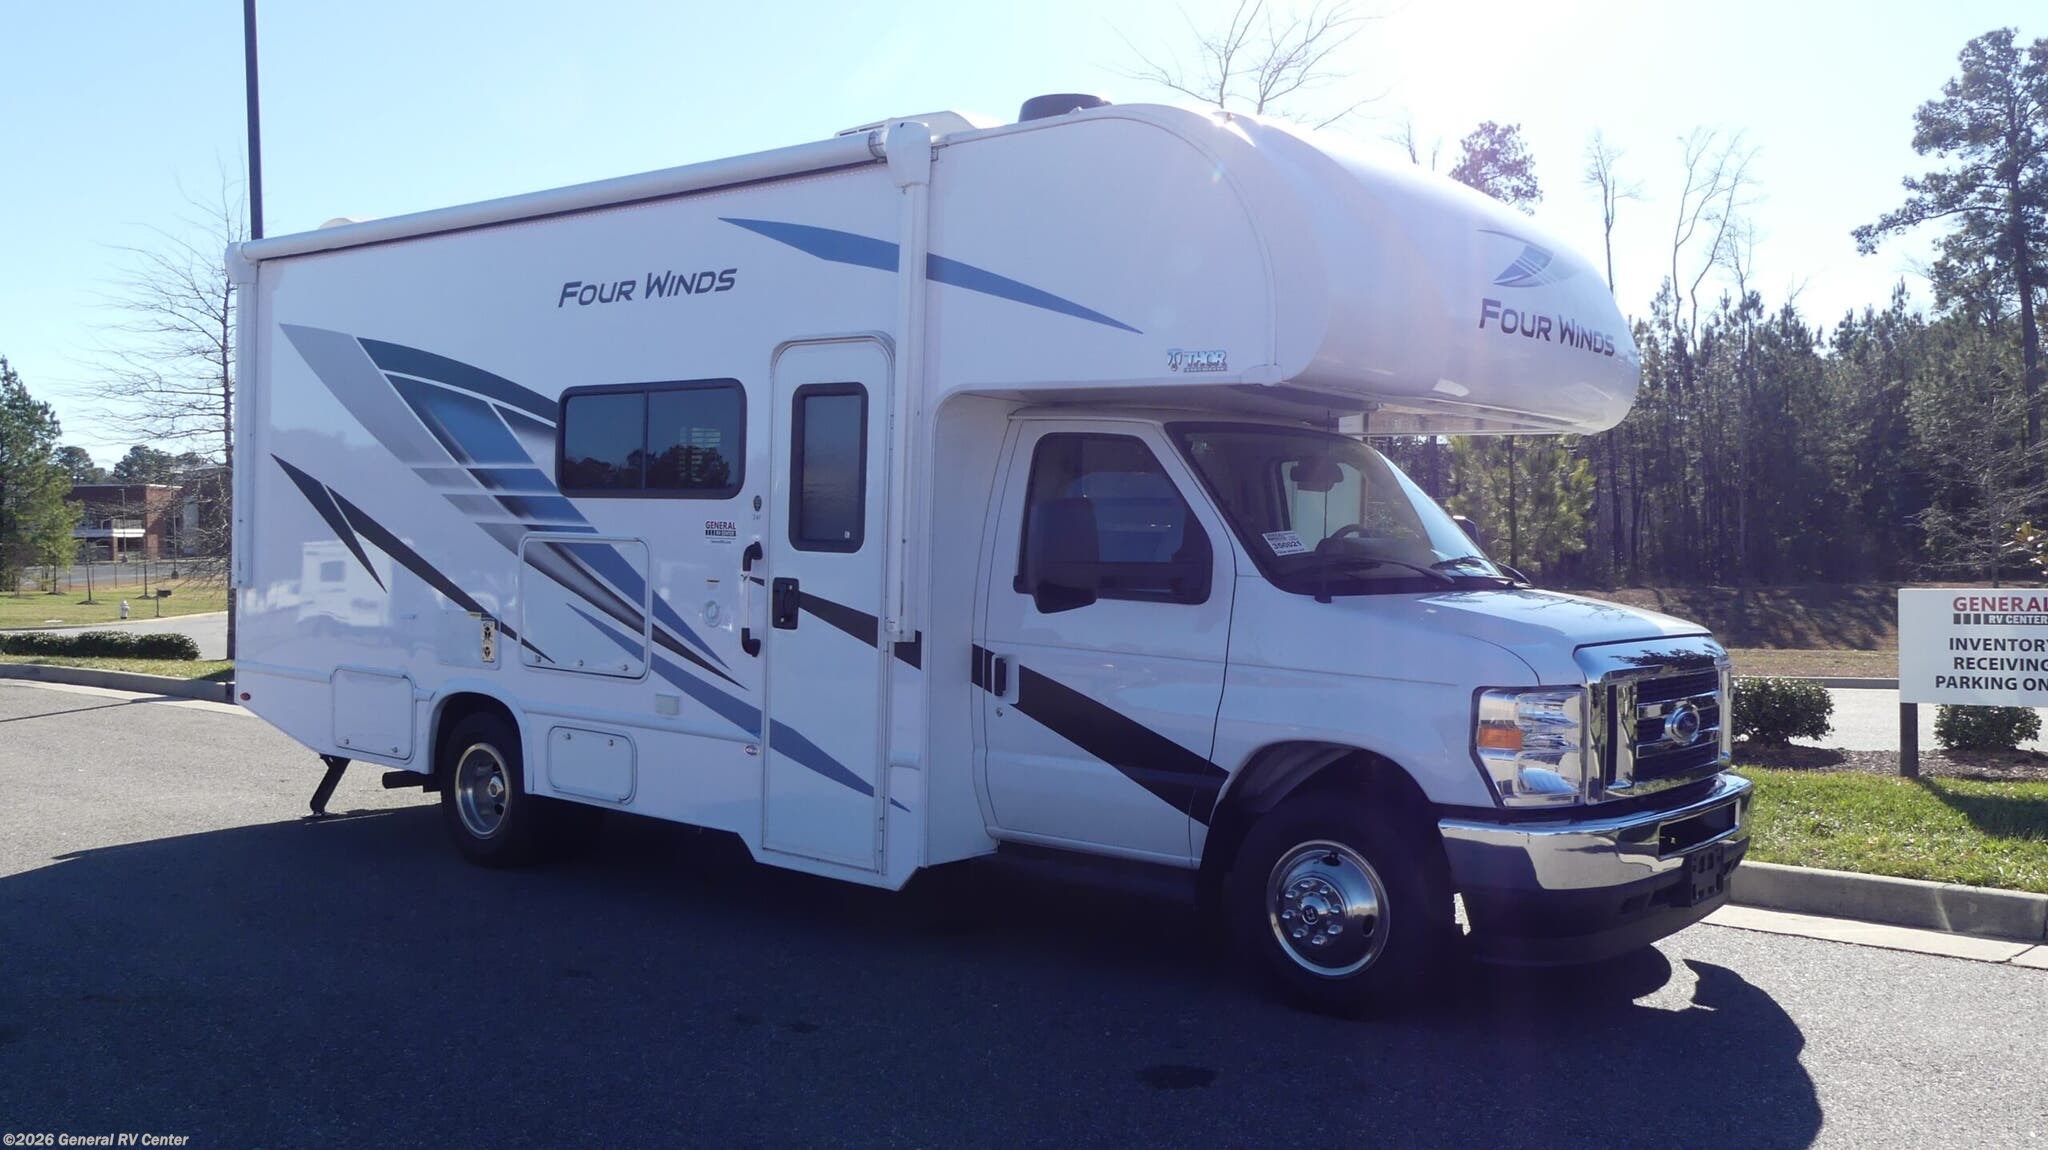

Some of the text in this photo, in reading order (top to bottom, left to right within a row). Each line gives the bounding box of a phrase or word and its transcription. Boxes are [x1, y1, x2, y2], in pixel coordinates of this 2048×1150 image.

[705, 521, 736, 530] GENERAL
[1989, 615, 2048, 625] RV CENTER
[1950, 638, 2048, 652] INVENTOR
[1936, 676, 2017, 691] PARKING
